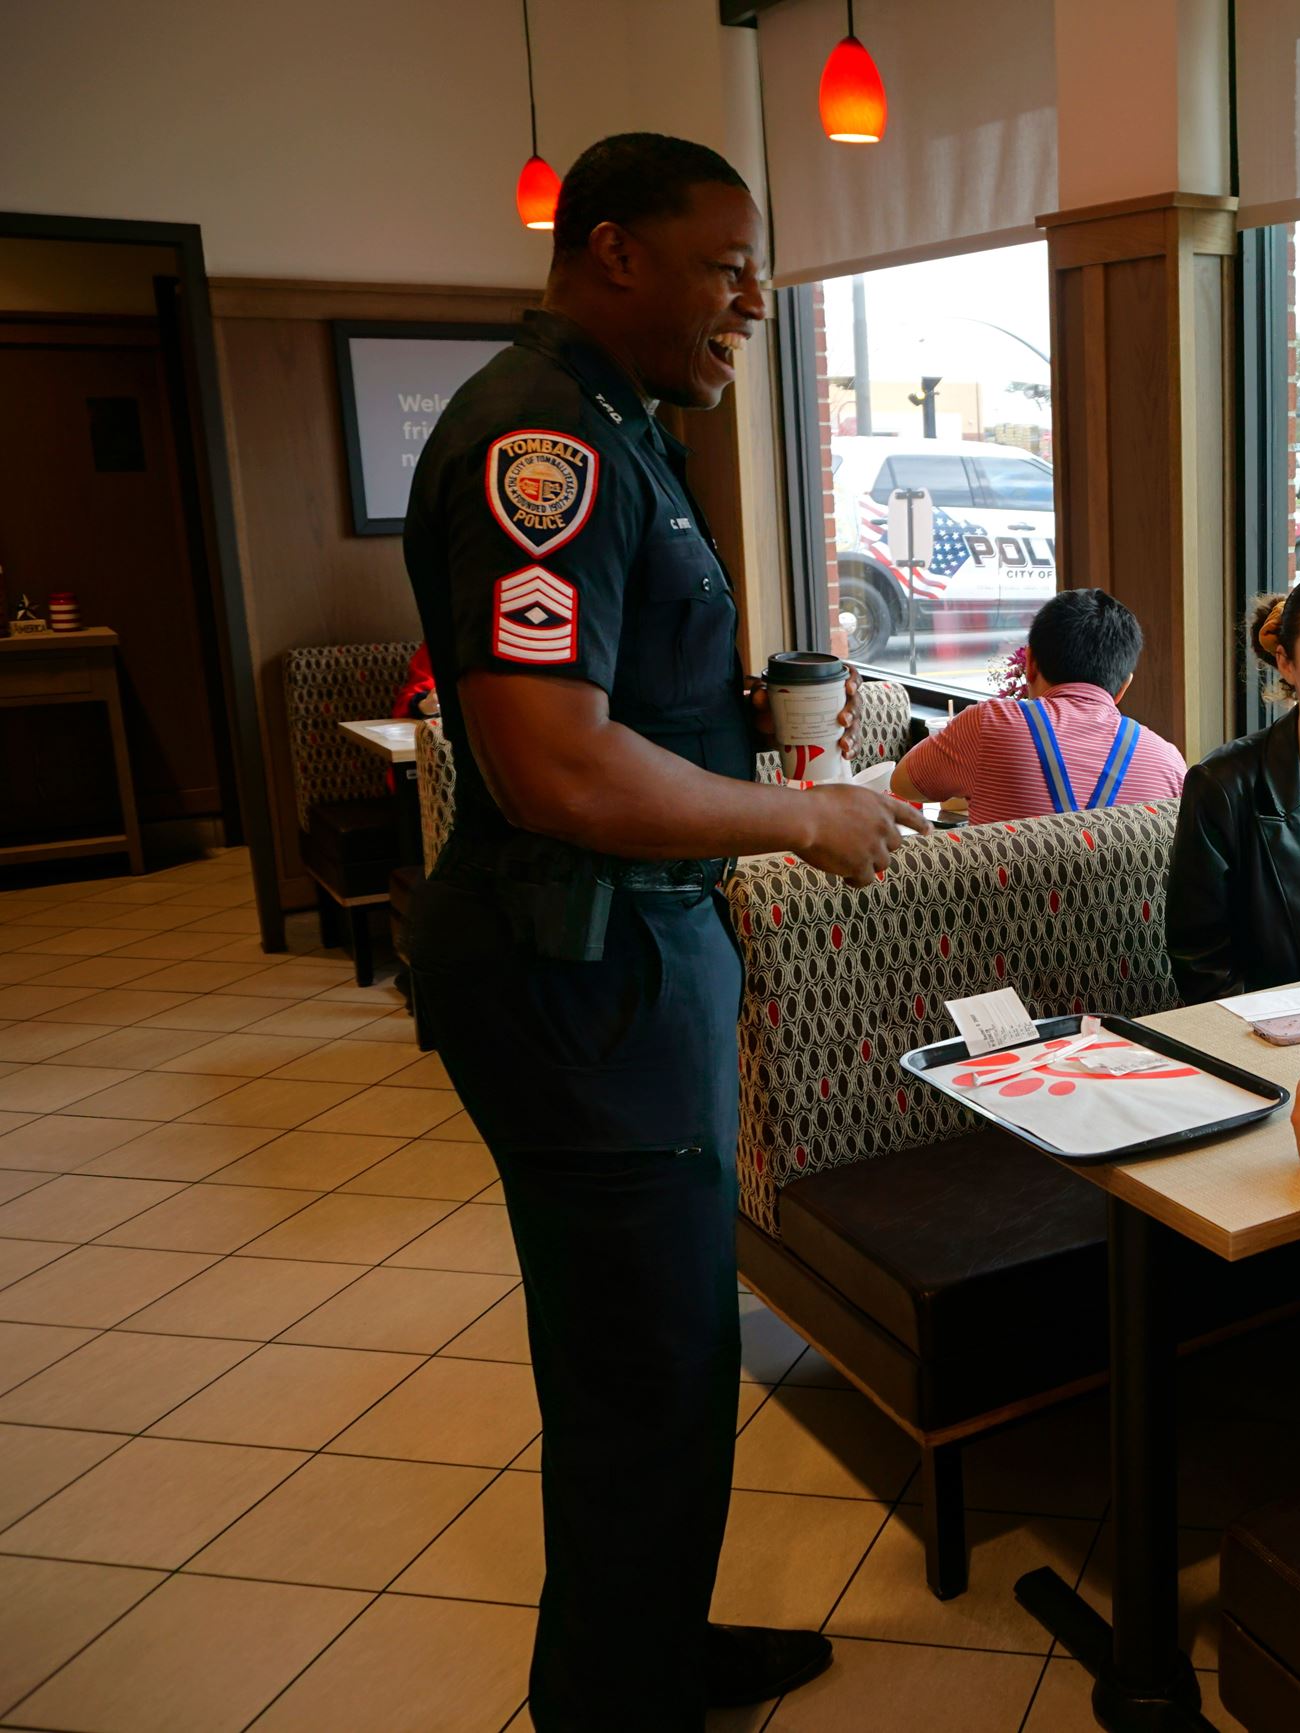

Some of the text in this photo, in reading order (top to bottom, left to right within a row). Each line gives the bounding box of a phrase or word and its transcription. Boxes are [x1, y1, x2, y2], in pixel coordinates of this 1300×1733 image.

[403, 421, 435, 440] fri
[502, 439, 584, 467] TOMBALL
[508, 475, 516, 489] THE
[512, 461, 526, 475] CITY
[526, 456, 534, 465] OF
[566, 473, 575, 496] TEXAS
[513, 510, 566, 529] POLICE
[1006, 570, 1053, 579] CITY OF
